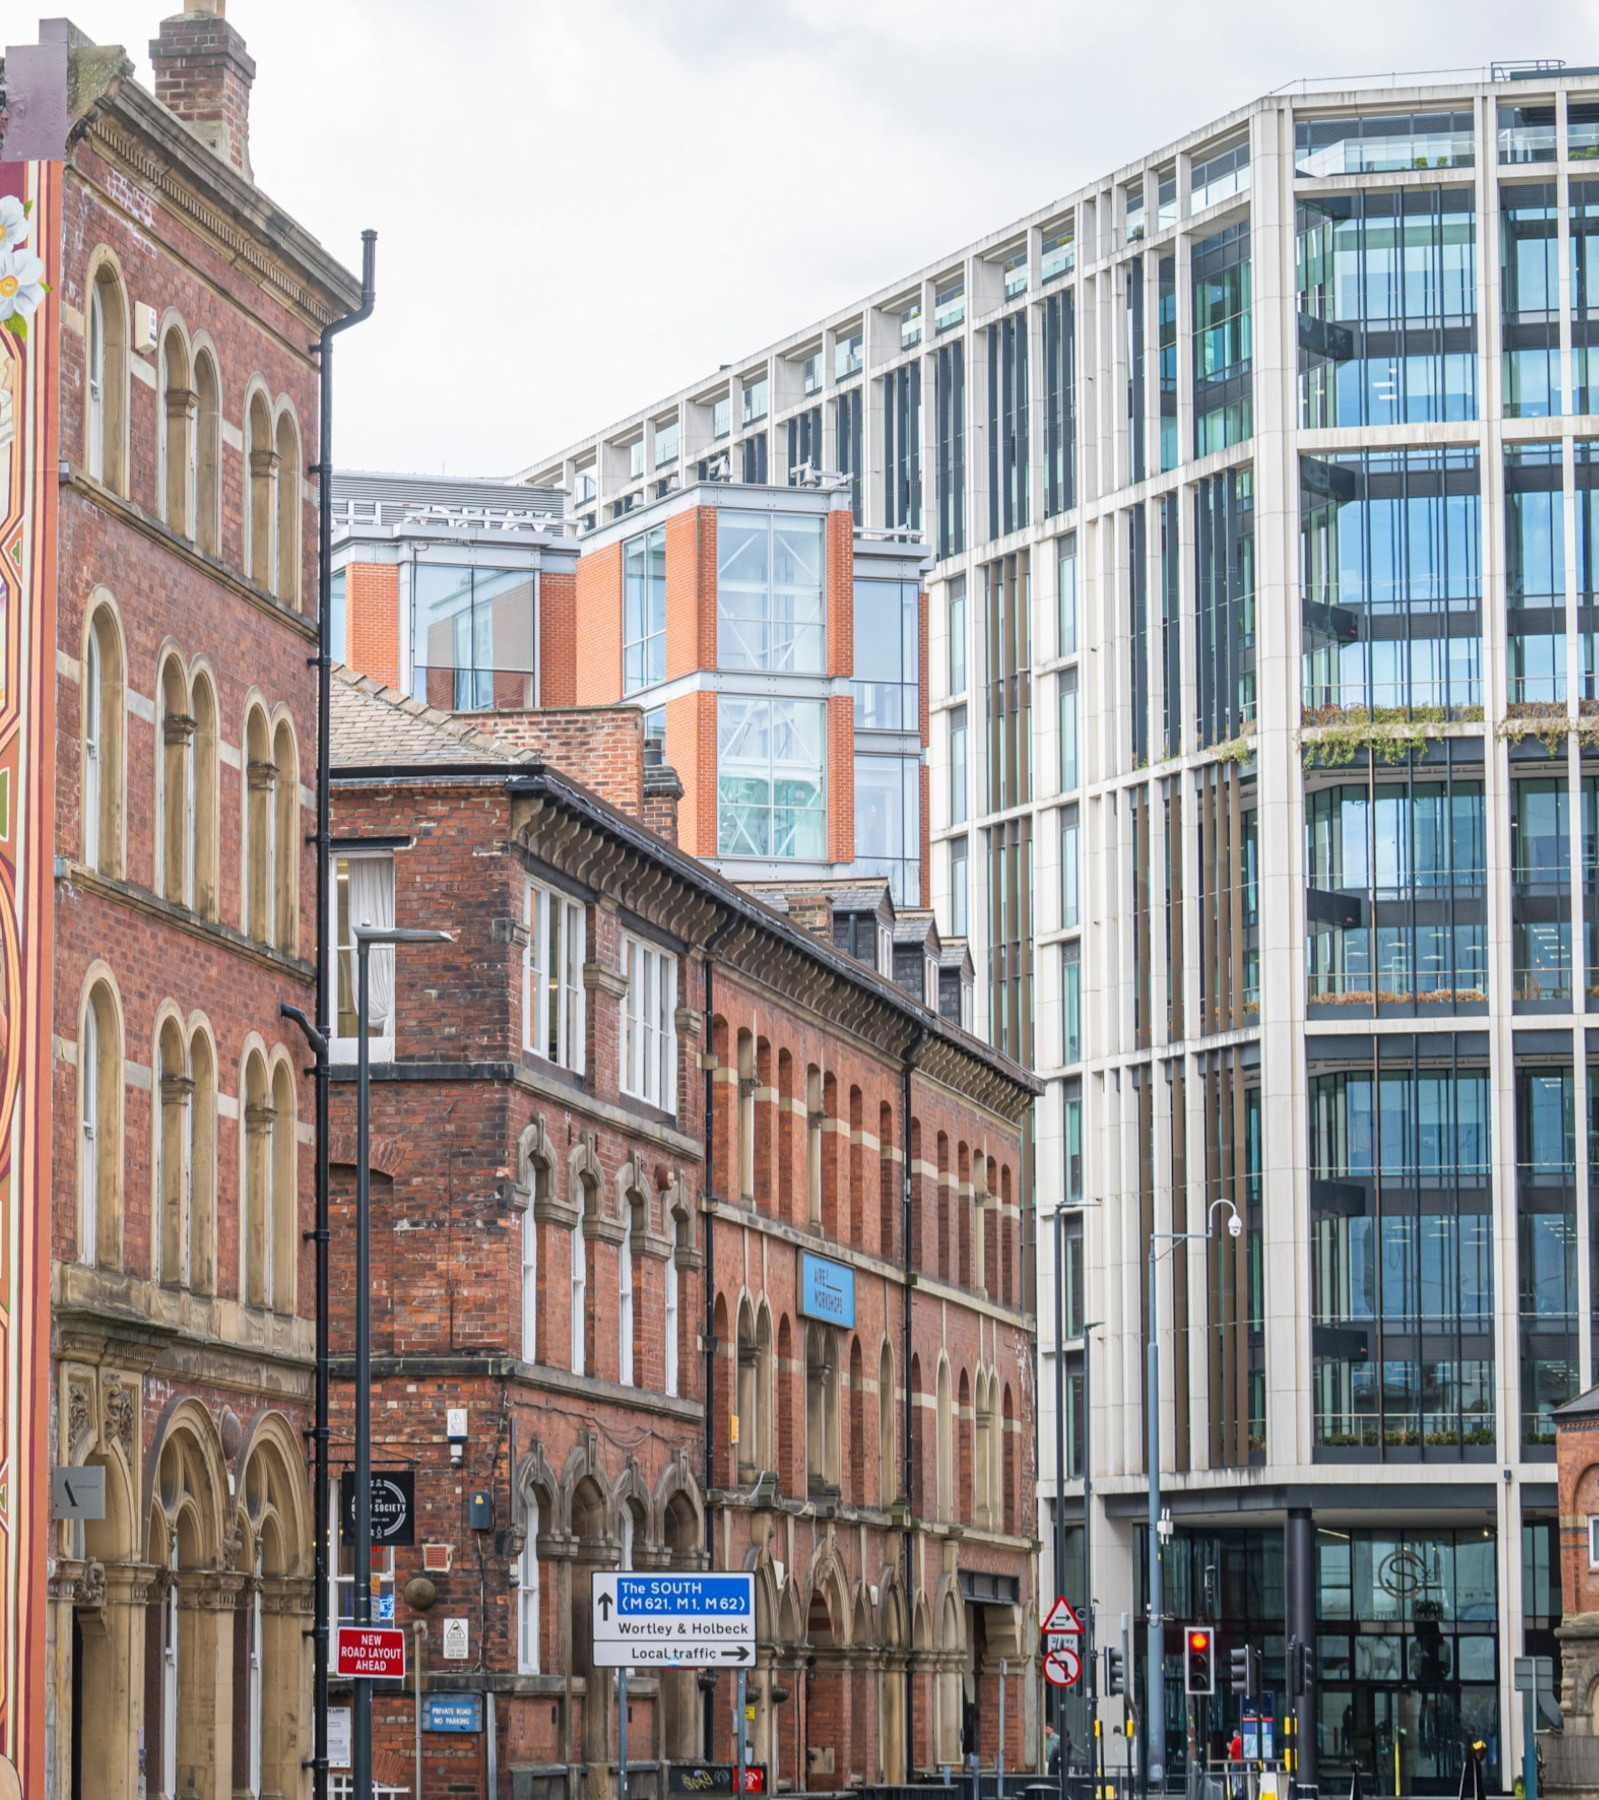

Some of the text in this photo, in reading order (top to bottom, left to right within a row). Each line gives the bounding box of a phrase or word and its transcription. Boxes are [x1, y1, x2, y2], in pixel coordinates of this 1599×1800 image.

[374, 1503, 406, 1512] SOCIETY
[621, 1582, 702, 1594] The SOUTH
[618, 1622, 749, 1636] Wortley & Holbeck
[361, 1634, 382, 1646] NEW
[341, 1646, 401, 1659] ROAD LAYOUT
[632, 1647, 717, 1659] Local traffic
[355, 1660, 387, 1671] AHEAD
[432, 1707, 472, 1715] PRIVATE ROAD
[434, 1717, 470, 1725] NO PARKING
